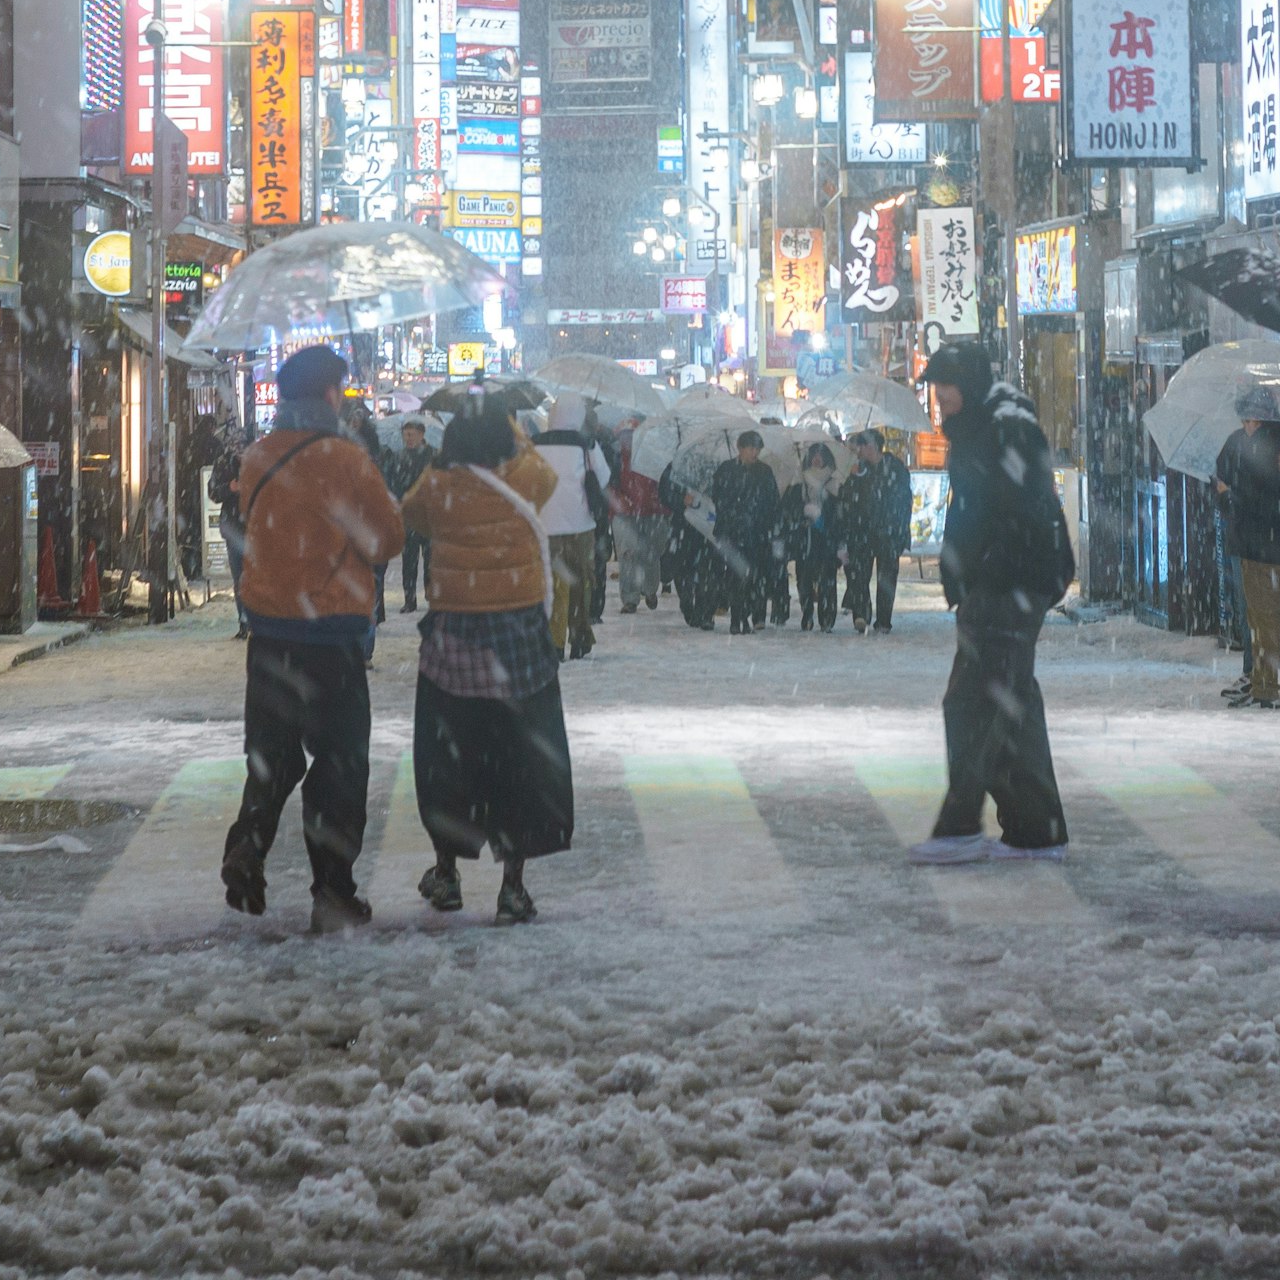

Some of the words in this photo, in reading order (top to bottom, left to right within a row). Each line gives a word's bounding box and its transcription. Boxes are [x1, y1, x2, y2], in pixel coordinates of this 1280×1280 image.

[1108, 11, 1157, 114] 本陣
[1246, 2, 1276, 85] 大衆
[1090, 122, 1177, 151] HONJIN
[1247, 94, 1276, 176] 酒場
[453, 230, 520, 253] SAUNA
[939, 218, 974, 322] お好み焼き
